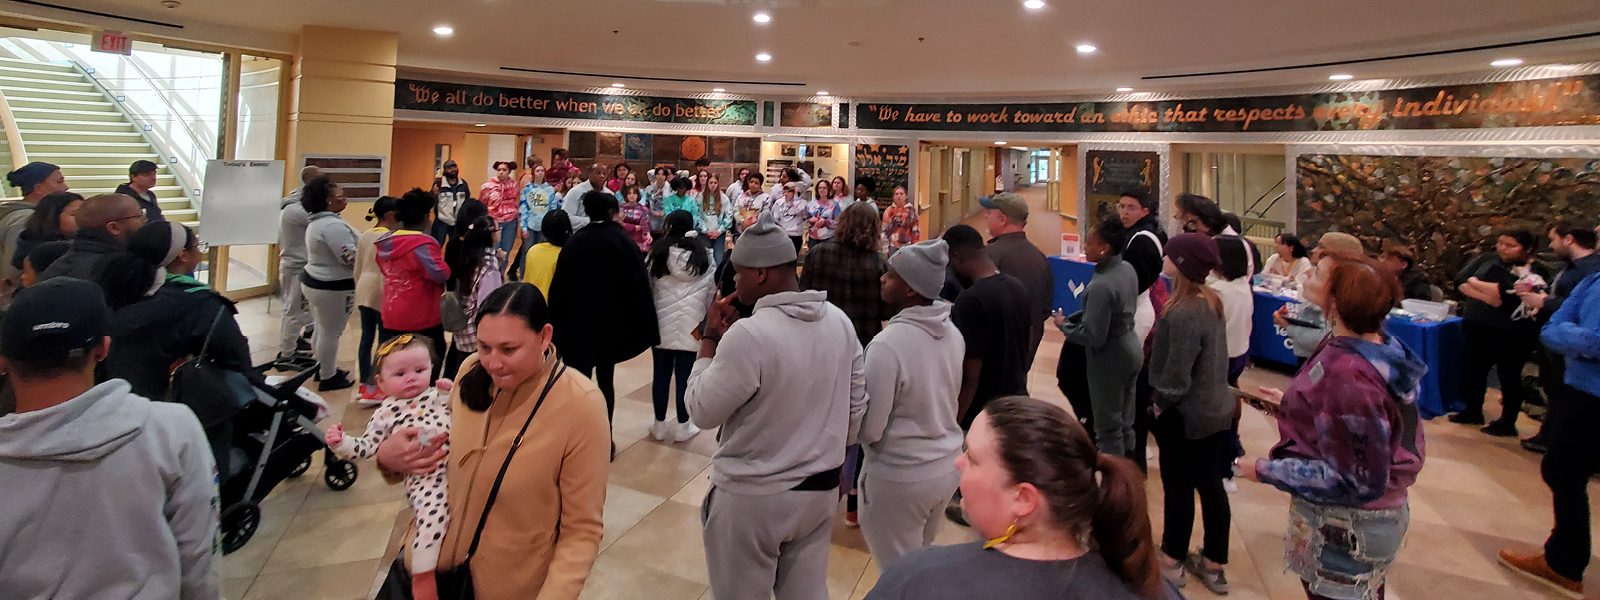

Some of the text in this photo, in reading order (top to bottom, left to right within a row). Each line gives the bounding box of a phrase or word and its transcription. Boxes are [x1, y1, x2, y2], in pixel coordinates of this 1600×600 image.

[102, 33, 128, 51] EXIT
[446, 90, 467, 105] all
[472, 91, 494, 107] do
[499, 93, 549, 110] better
[556, 97, 597, 114] when
[602, 101, 625, 115] we
[629, 101, 650, 116] al
[652, 102, 671, 117] do
[904, 106, 942, 123] have
[946, 110, 963, 123] to
[967, 106, 1008, 123] work
[1013, 106, 1078, 124] toward
[1080, 111, 1105, 124] an
[1109, 103, 1158, 124] ethic
[1164, 103, 1208, 123] that
[1213, 103, 1306, 131] respects
